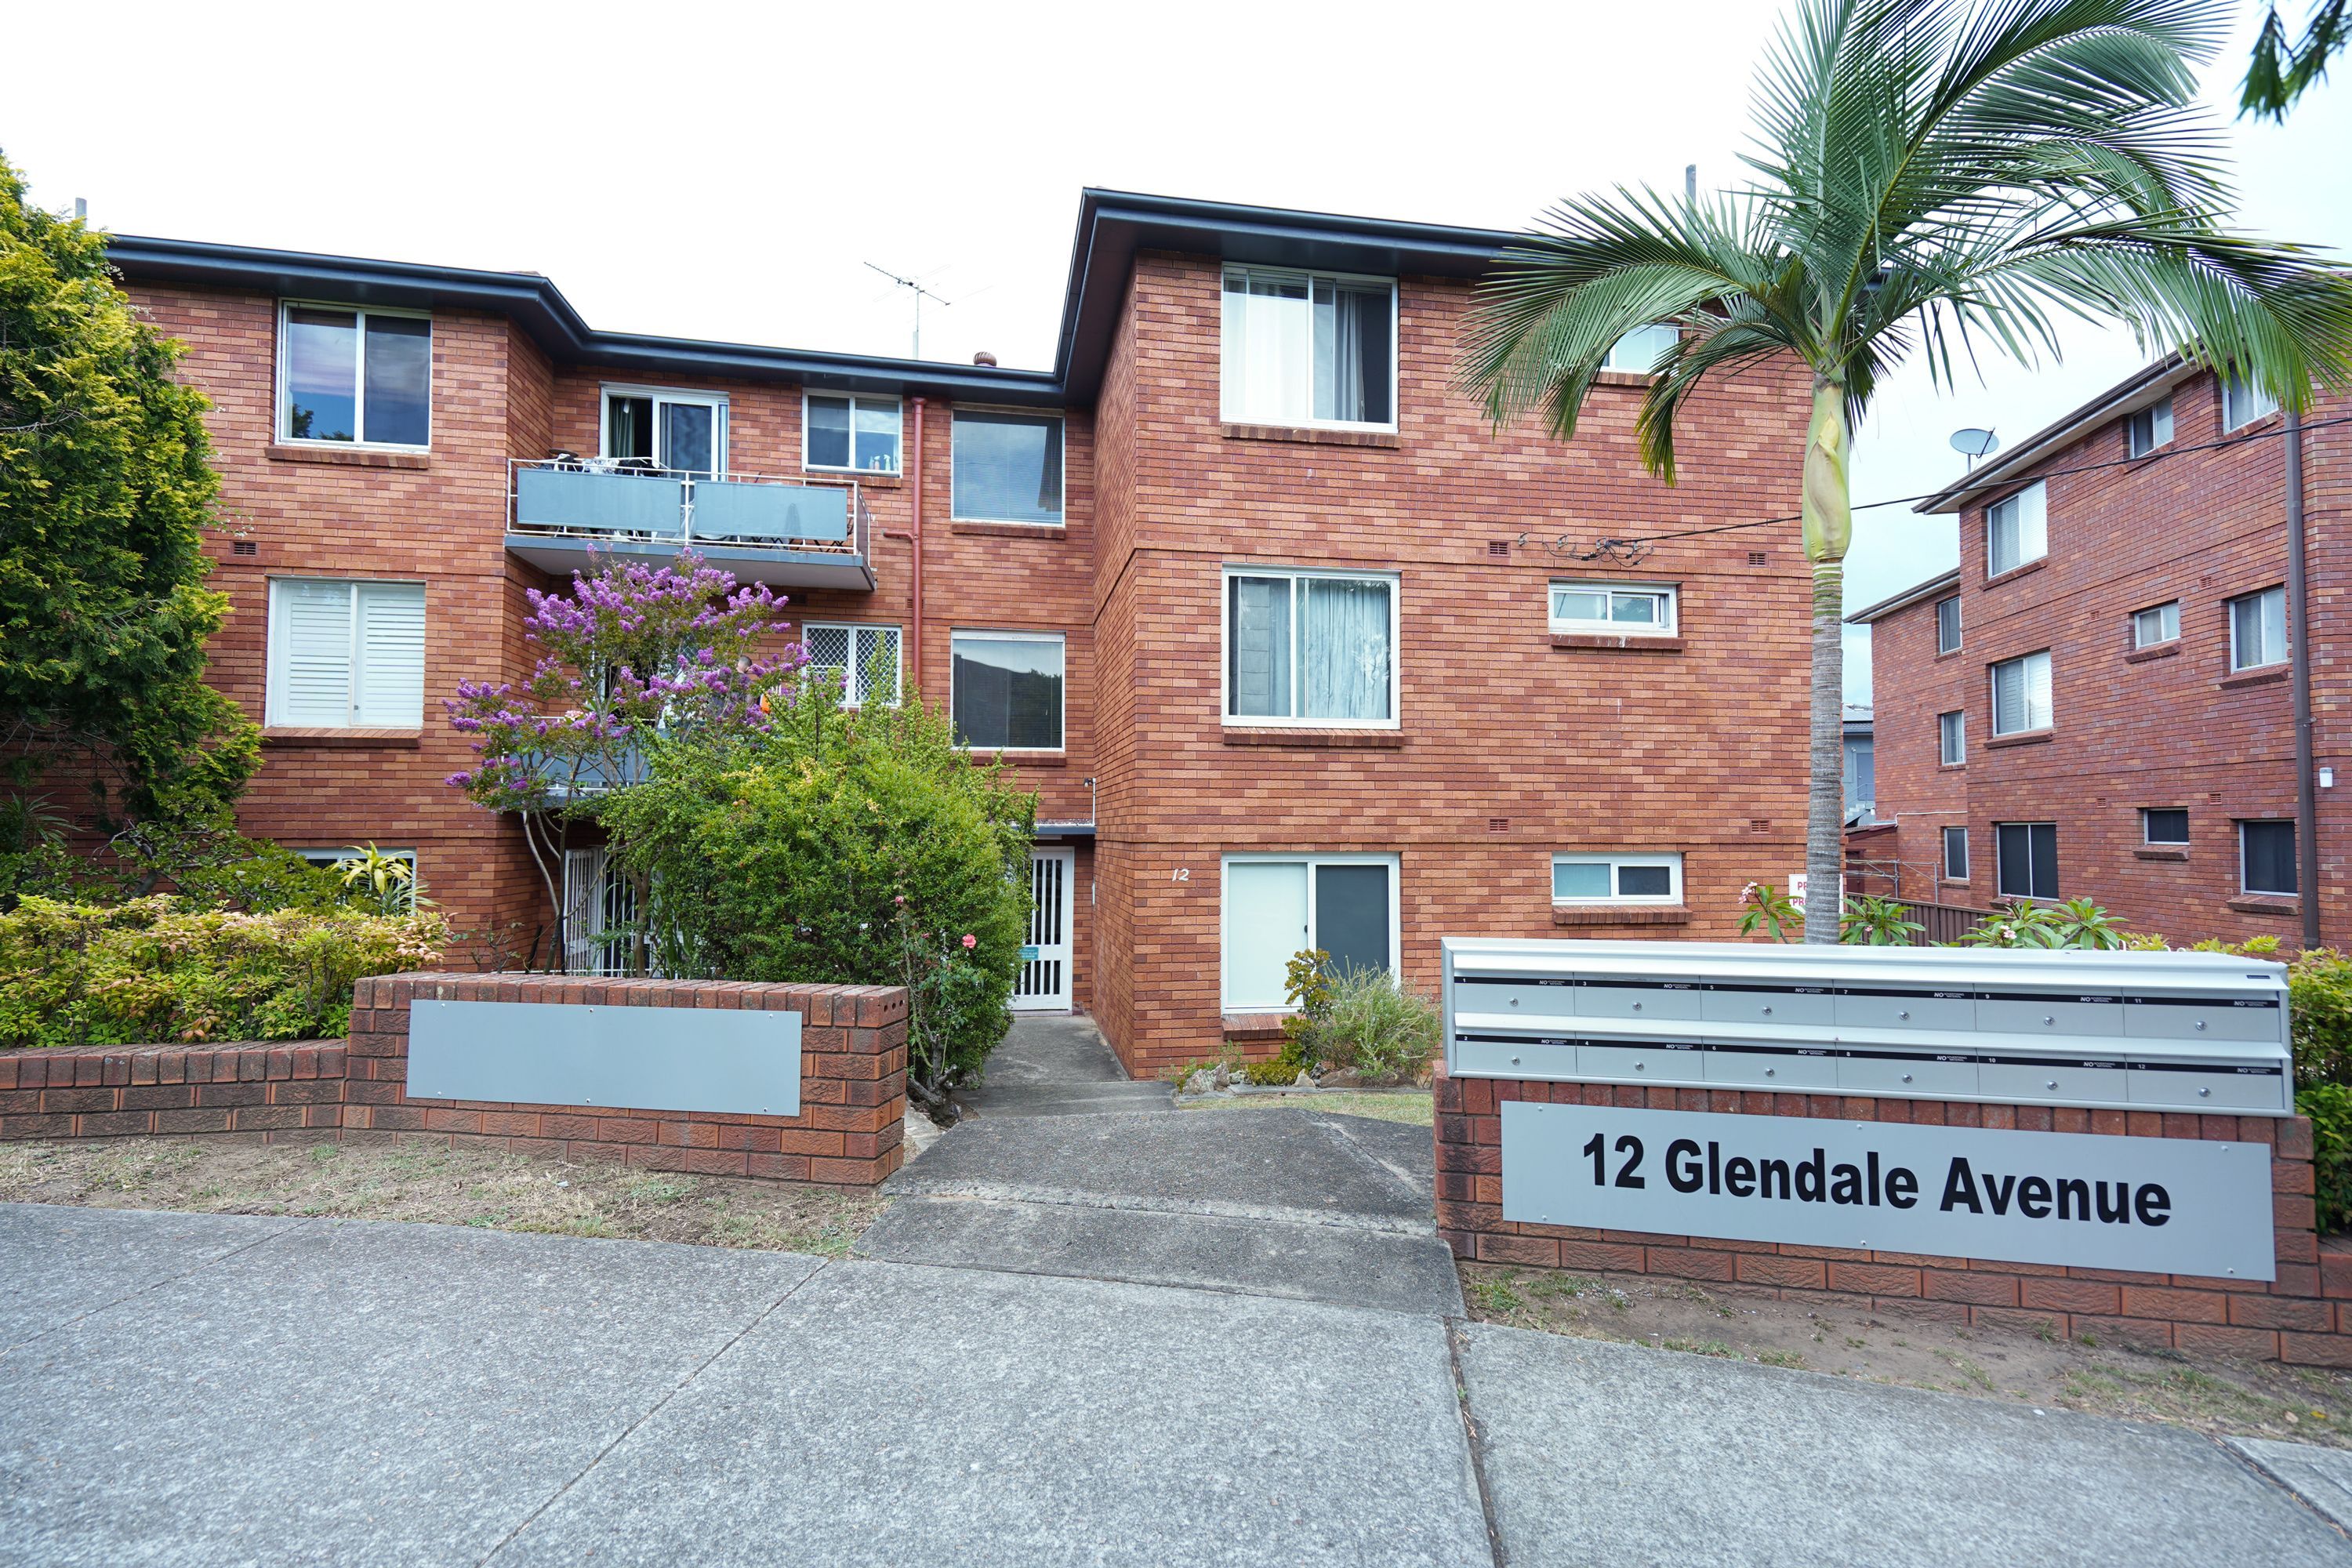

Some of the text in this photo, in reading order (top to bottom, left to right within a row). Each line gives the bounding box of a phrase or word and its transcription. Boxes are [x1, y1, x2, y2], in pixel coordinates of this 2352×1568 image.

[1172, 868, 1189, 882] 12
[1584, 1133, 2171, 1227] 12 Glendale Avenue
